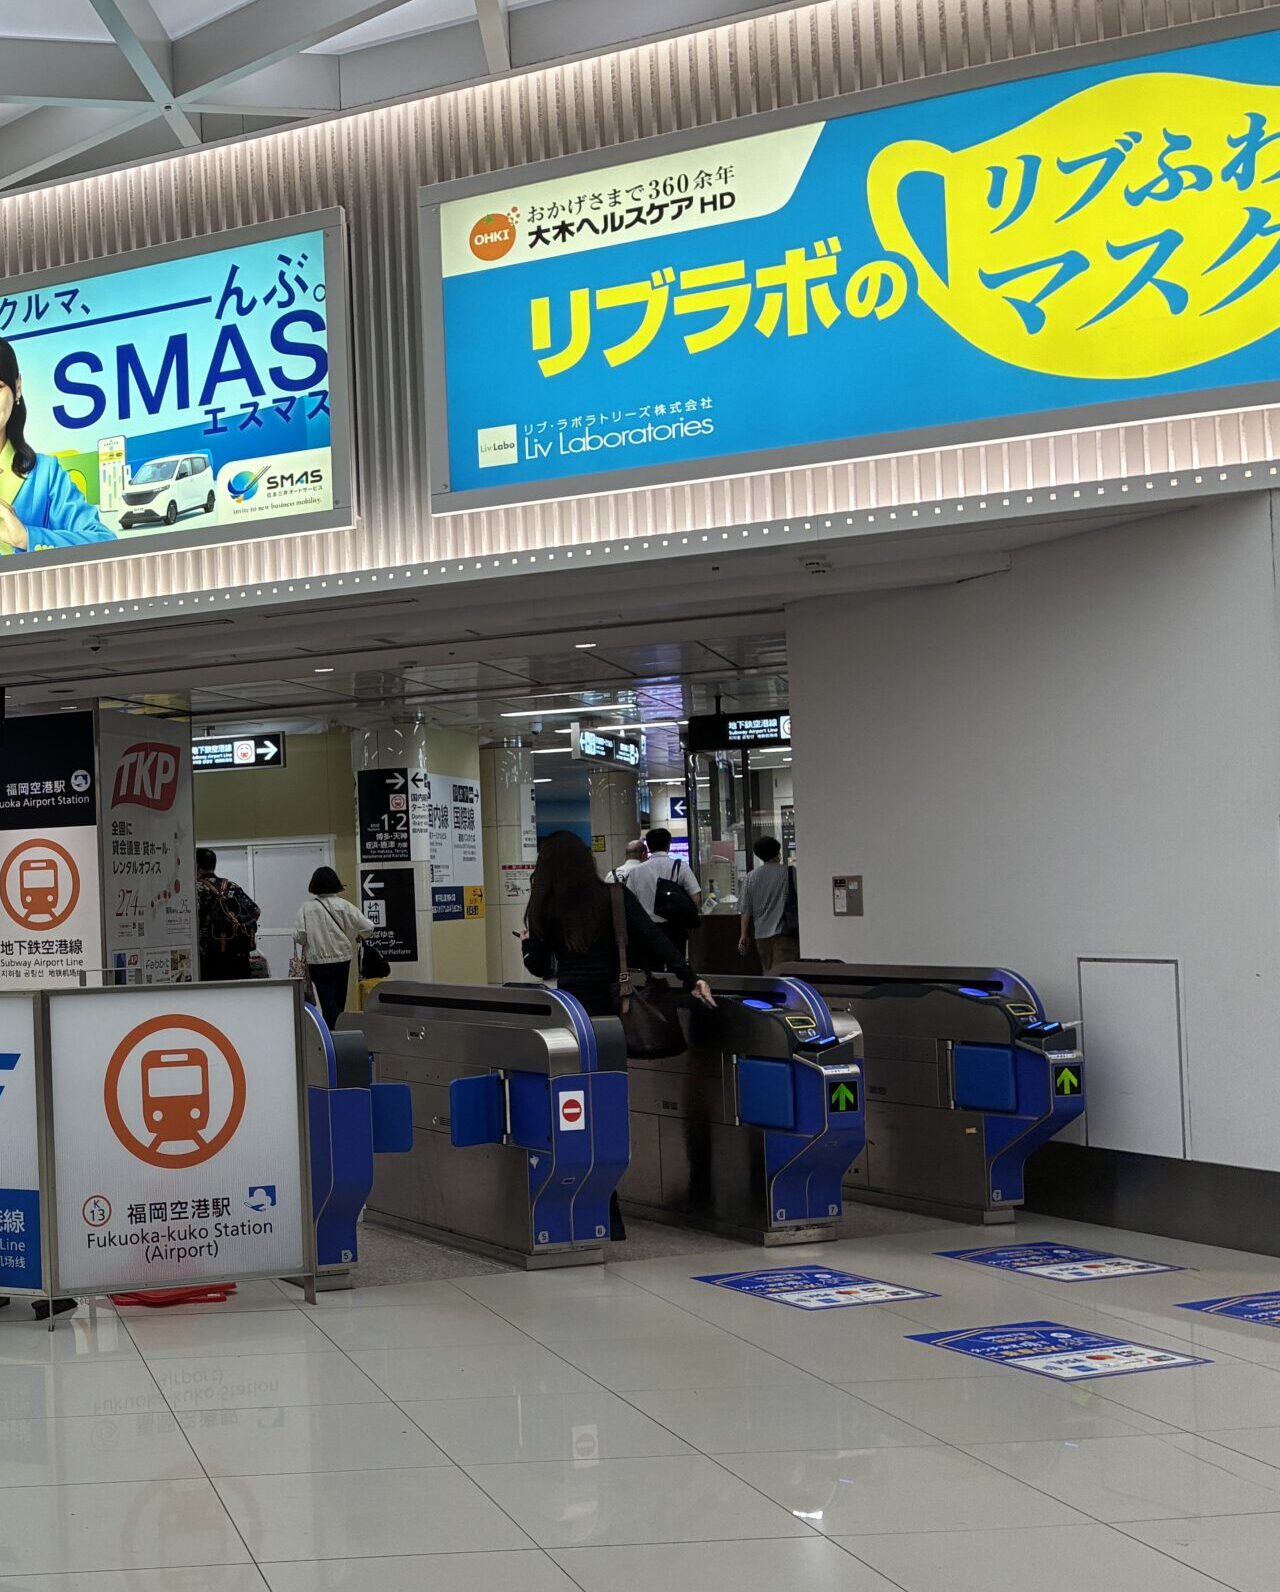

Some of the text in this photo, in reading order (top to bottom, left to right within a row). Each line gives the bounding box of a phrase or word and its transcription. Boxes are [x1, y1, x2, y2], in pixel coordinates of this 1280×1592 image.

[527, 164, 736, 224] おかげさまで360余年
[474, 228, 510, 245] OHKI
[978, 206, 1280, 336] マスク
[531, 236, 908, 379] リブラボの
[53, 309, 329, 429] SMAS
[203, 389, 330, 436] エスマス
[525, 417, 714, 460] Liv Laboratories
[266, 469, 323, 490] SMAS
[270, 500, 295, 510] business
[118, 751, 176, 800] TKP
[6, 780, 66, 797] 福岡空港駅
[23, 796, 55, 808] Airport
[57, 794, 90, 805] Station
[112, 860, 162, 875] レンタルオフィス
[0, 940, 84, 956] 地下鉄空港線
[0, 957, 84, 968] Subway Airport Line
[93, 1199, 101, 1209] K
[127, 1197, 232, 1226] 福岡空港駅
[89, 1208, 106, 1222] 13
[0, 1237, 26, 1252] Line
[86, 1219, 274, 1249] Fukuoka-kuko Station
[144, 1242, 220, 1264] (Airport)
